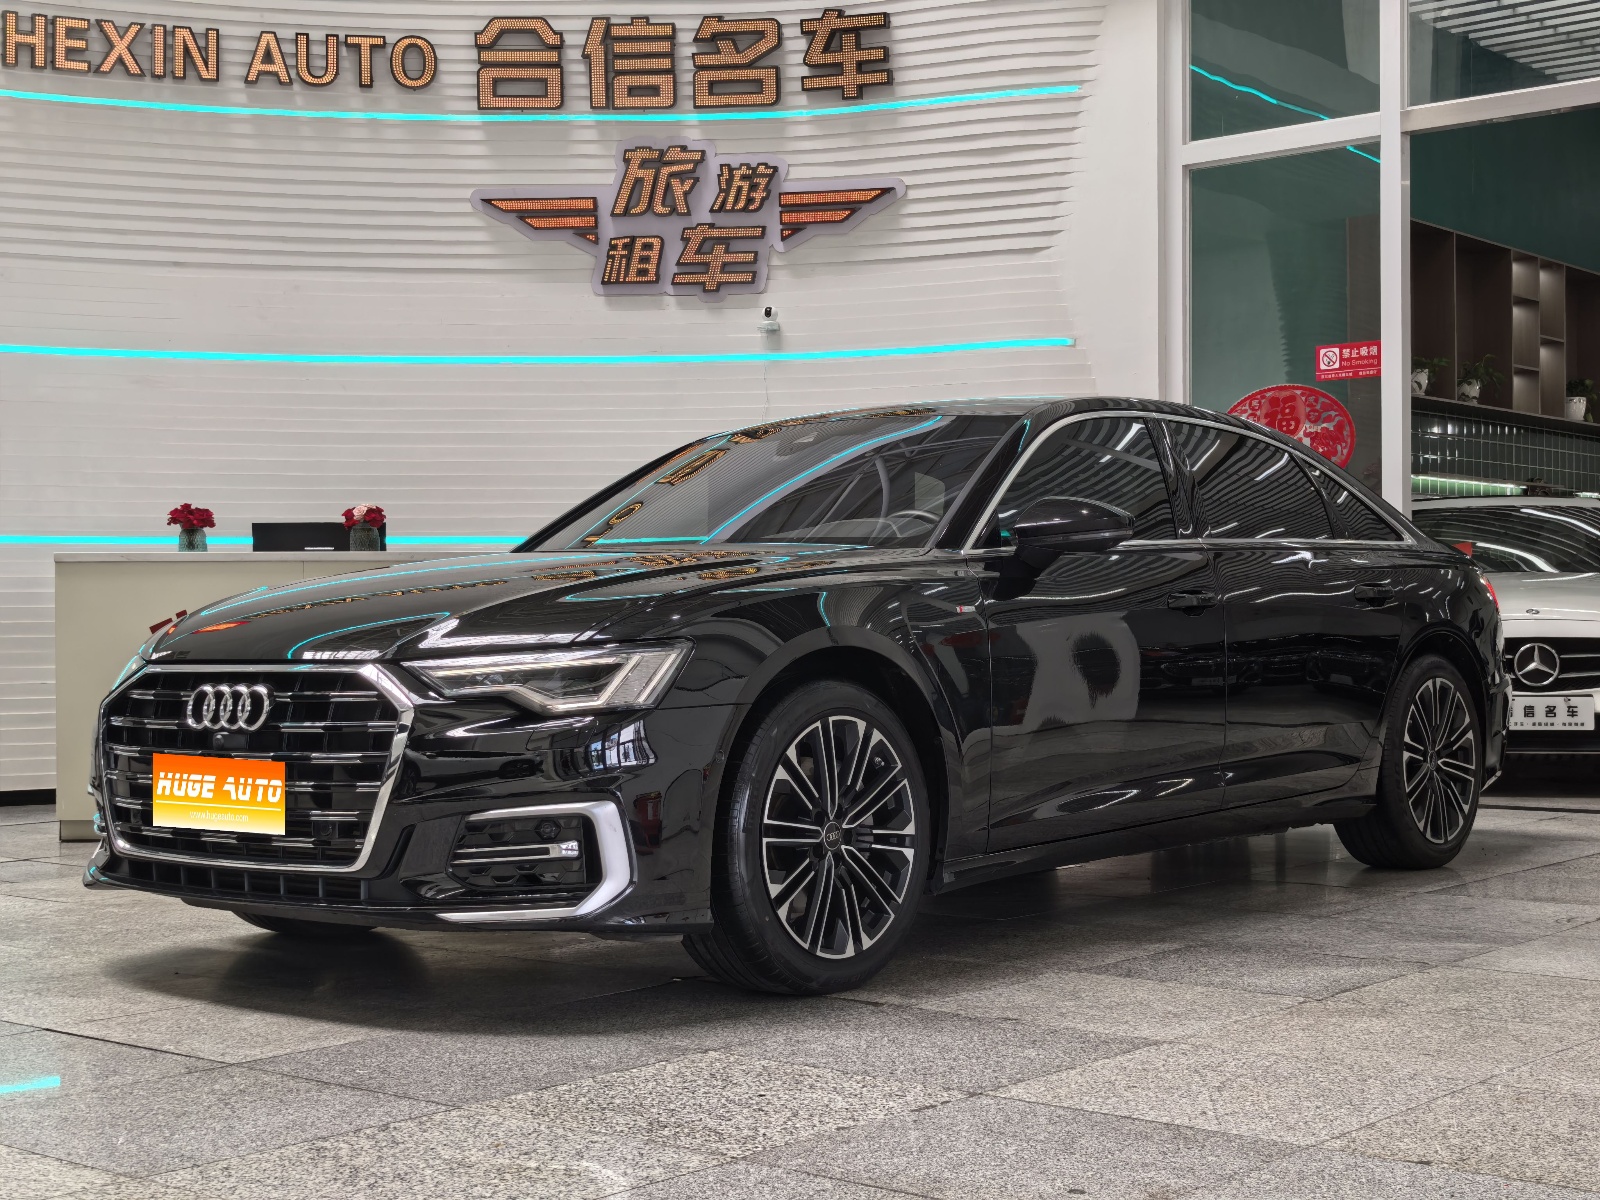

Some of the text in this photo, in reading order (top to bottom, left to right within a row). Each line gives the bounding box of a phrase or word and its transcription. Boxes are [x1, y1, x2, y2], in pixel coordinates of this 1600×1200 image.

[2, 10, 438, 90] HEXIN AUTO
[475, 9, 892, 111] 合信名车
[610, 144, 779, 218] 旅游
[600, 222, 767, 293] 租车
[1341, 345, 1378, 359] 禁止吸烟
[1351, 358, 1378, 366] Smoking
